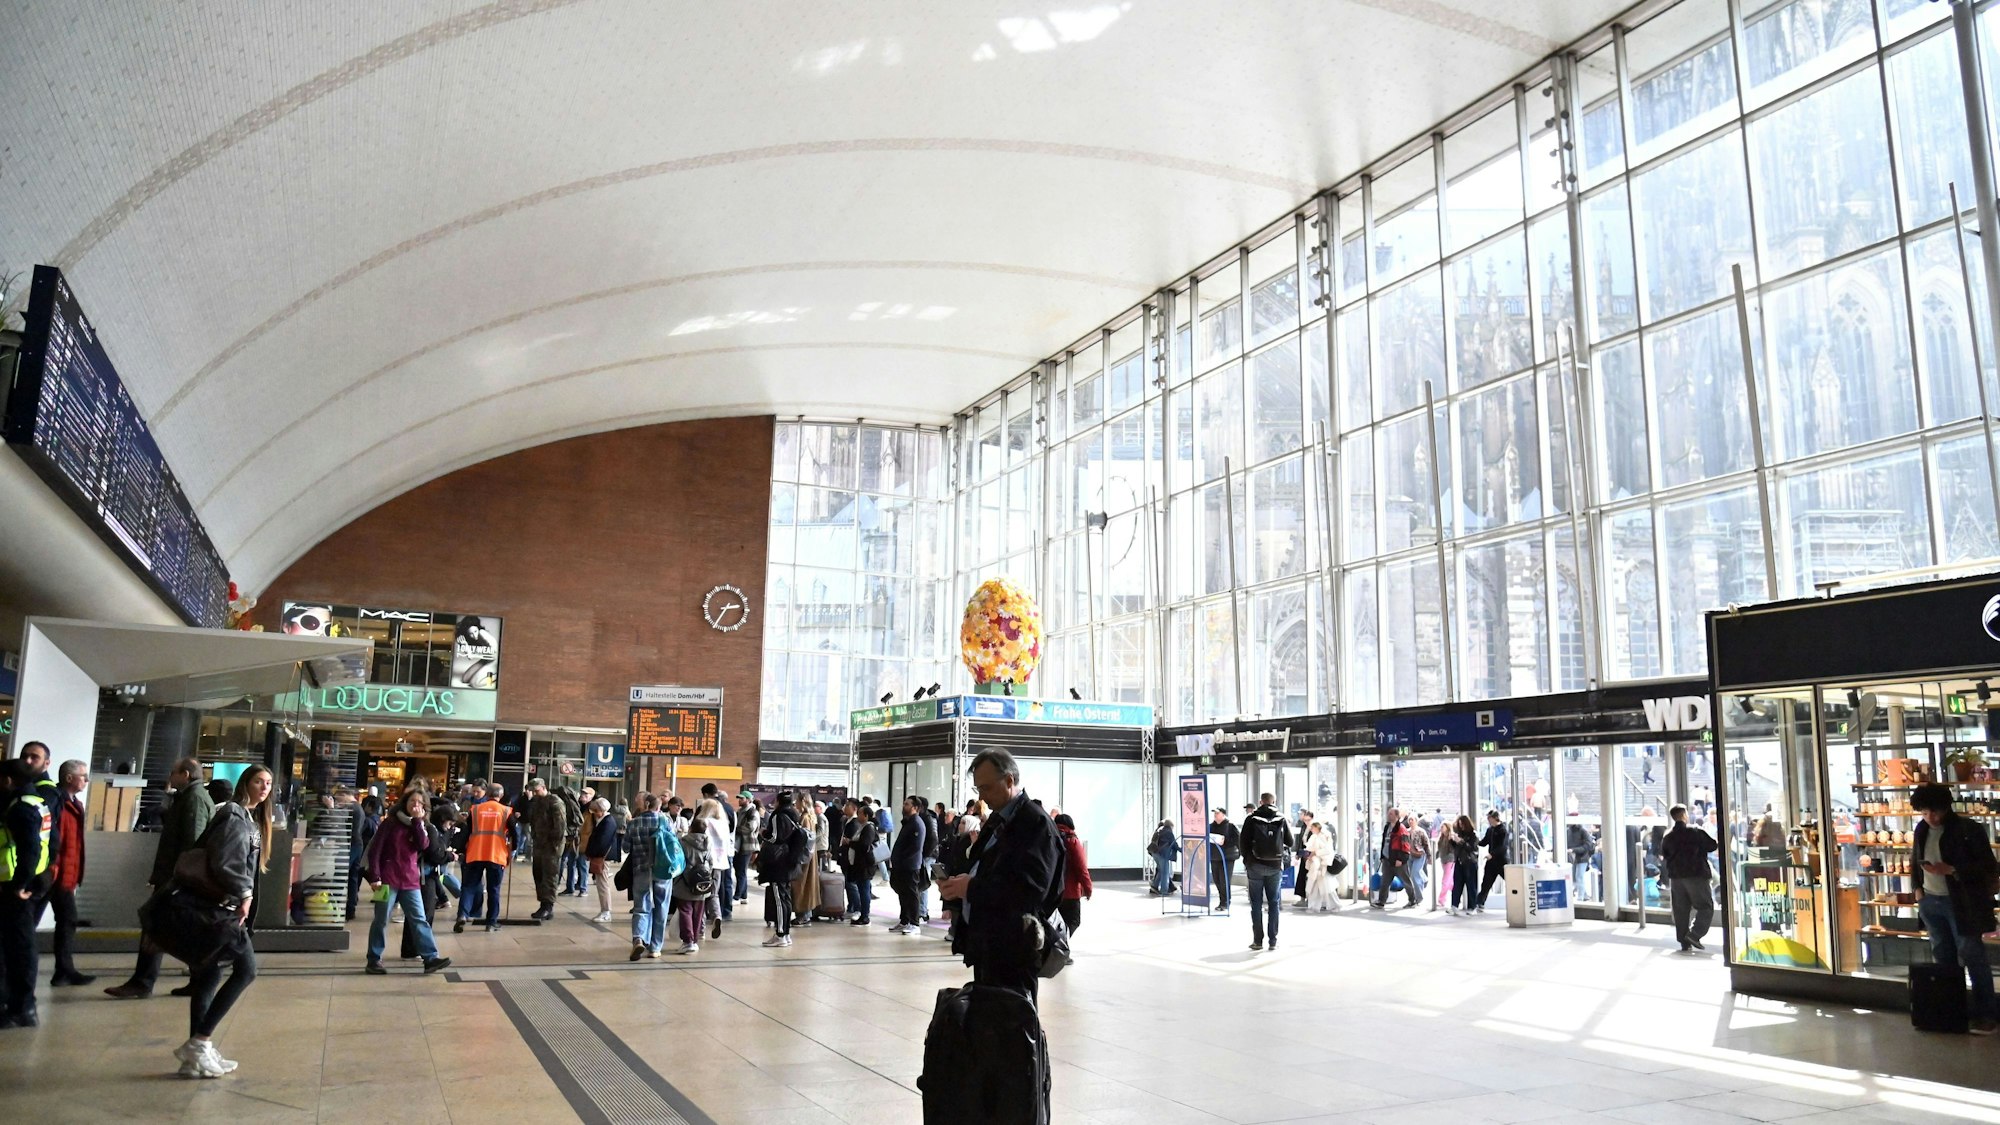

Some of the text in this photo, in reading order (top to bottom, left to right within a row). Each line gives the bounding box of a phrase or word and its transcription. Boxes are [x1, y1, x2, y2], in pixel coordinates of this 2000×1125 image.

[321, 686, 454, 715] DOUGLAS
[1053, 706, 1121, 721] Frohe Ostern!
[597, 746, 614, 763] U
[1175, 733, 1217, 757] WDR
[1528, 883, 1537, 916] Abfall
